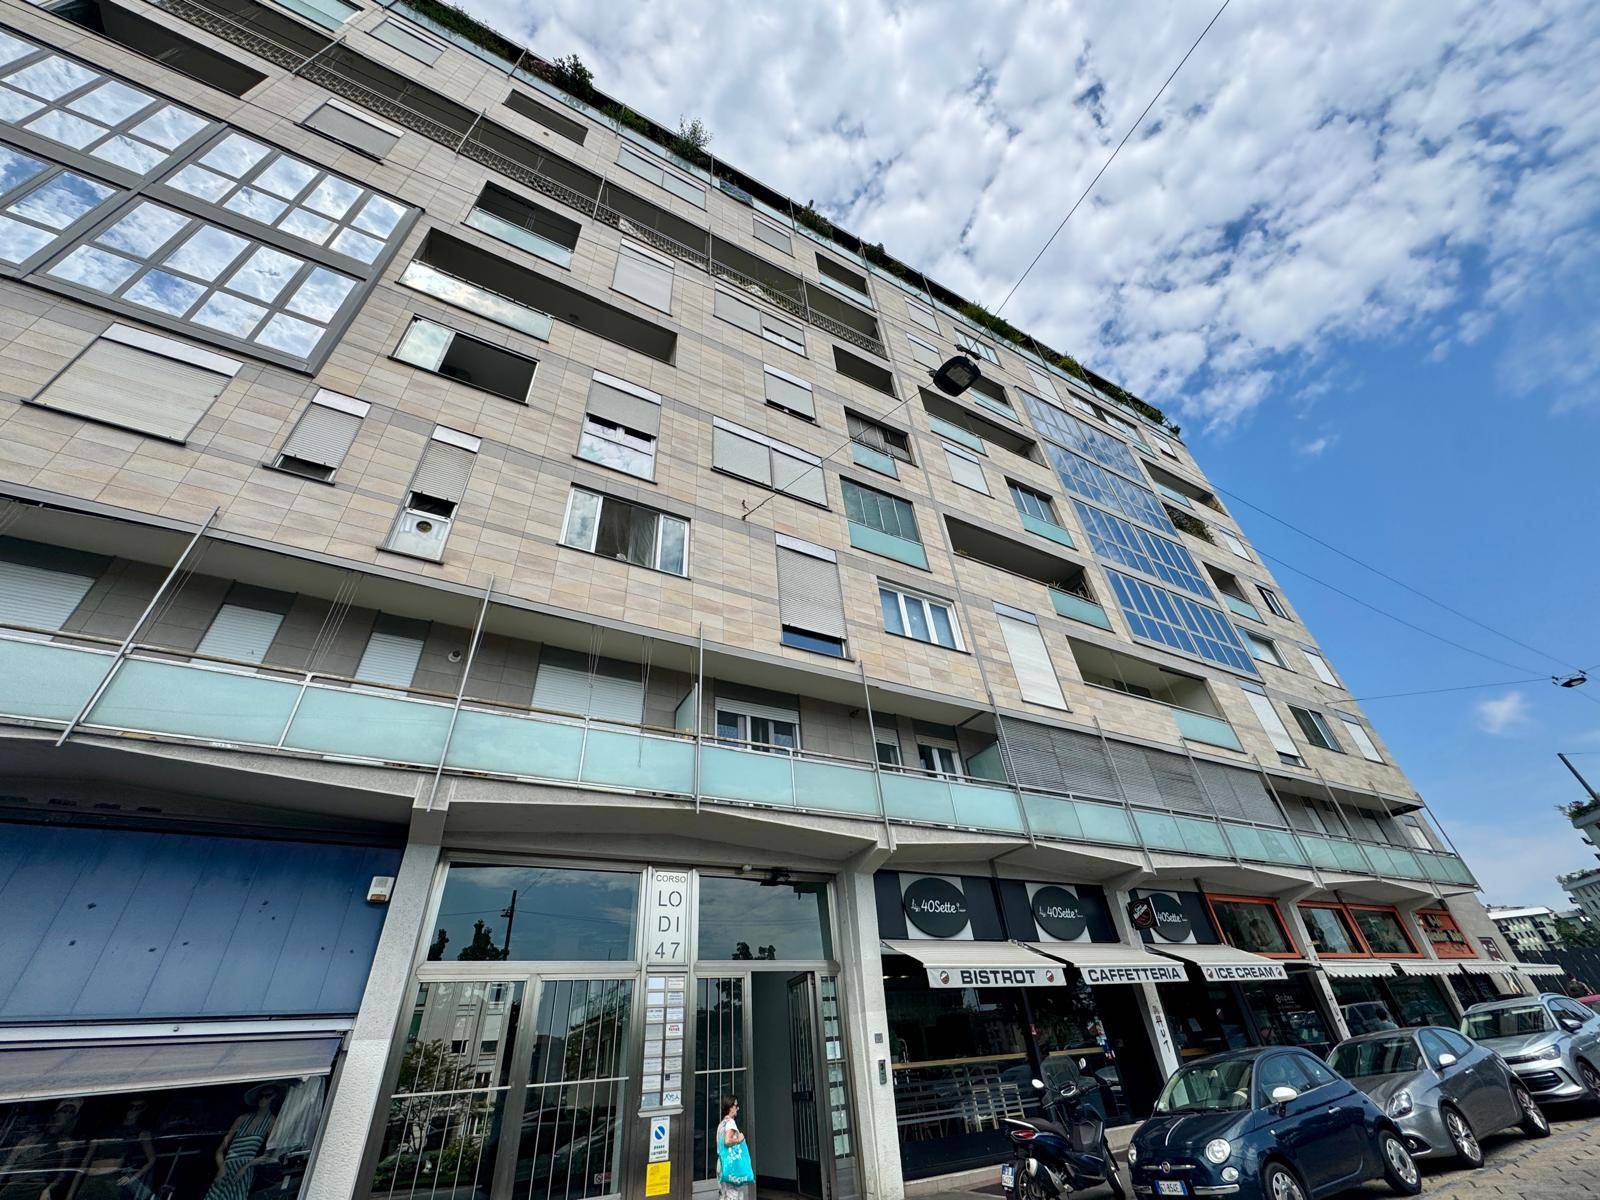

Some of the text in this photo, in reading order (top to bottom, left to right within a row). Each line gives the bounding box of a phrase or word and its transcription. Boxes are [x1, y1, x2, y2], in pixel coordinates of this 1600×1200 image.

[655, 874, 687, 884] CORSO
[654, 941, 681, 959] 47
[960, 970, 1036, 985] BISTROT
[1088, 967, 1182, 983] CAFFETTERIA
[1215, 966, 1277, 980] ICE CREAM
